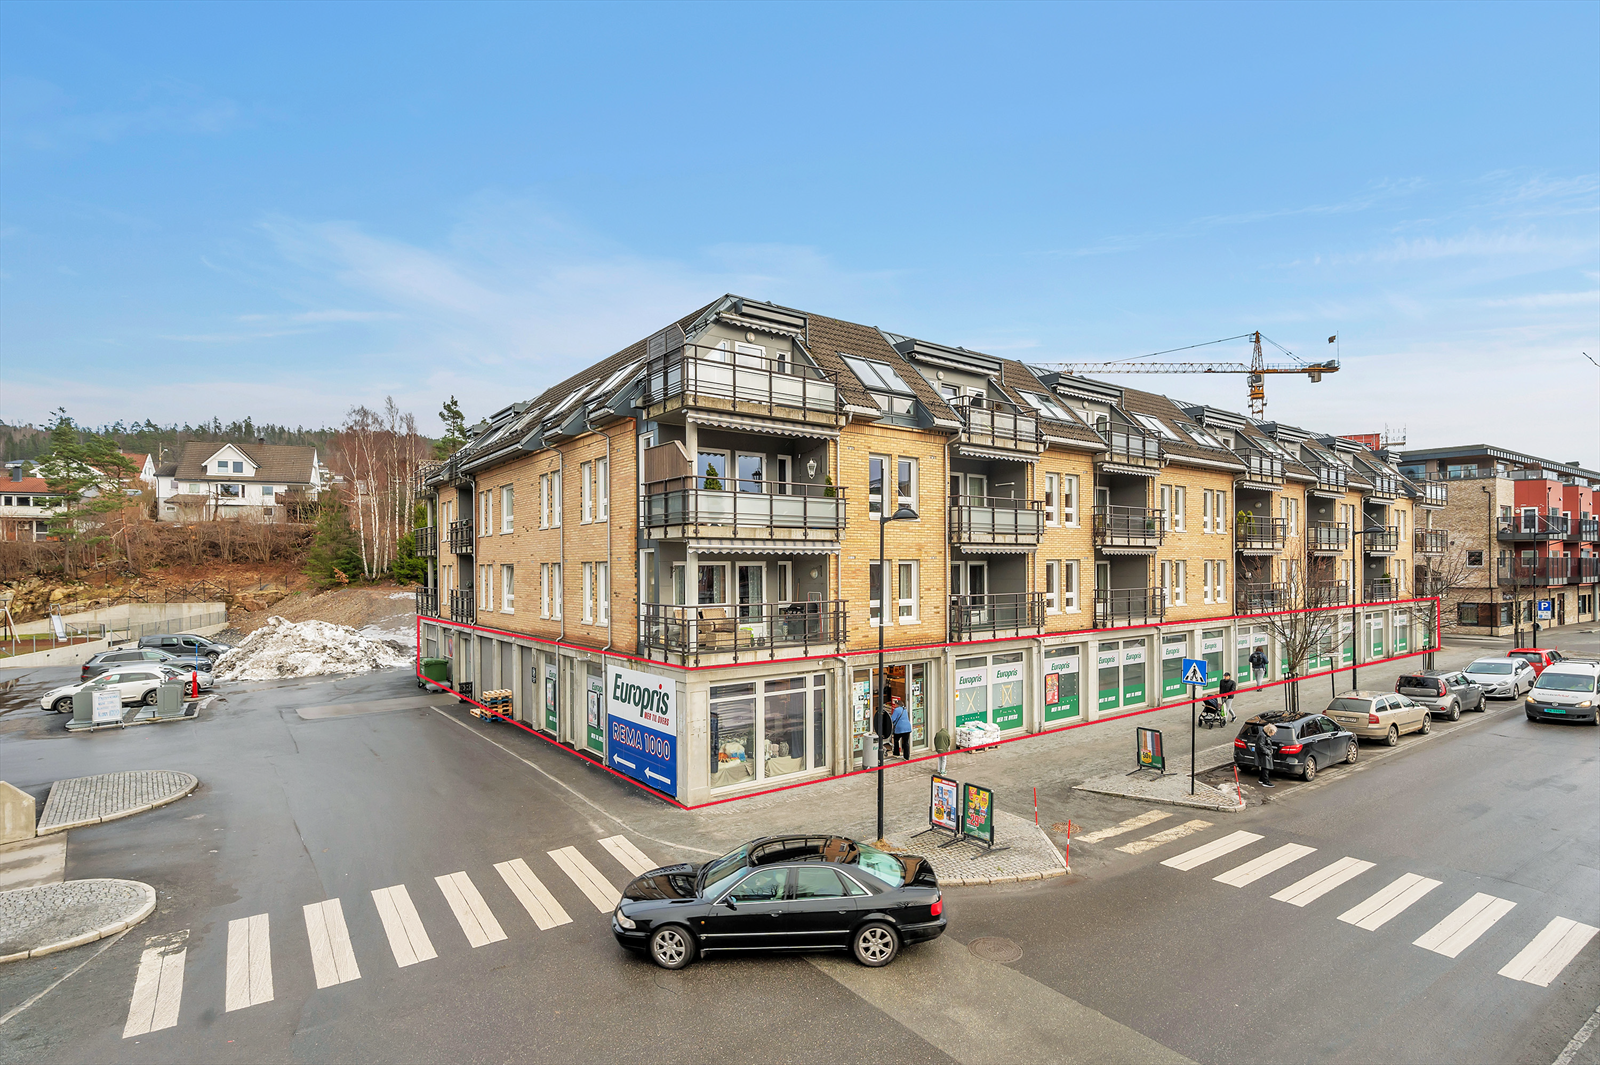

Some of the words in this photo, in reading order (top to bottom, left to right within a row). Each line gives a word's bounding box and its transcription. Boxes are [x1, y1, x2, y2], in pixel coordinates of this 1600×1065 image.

[1541, 602, 1548, 610] P
[1204, 641, 1217, 650] Europris
[1166, 647, 1180, 656] Europris
[1099, 656, 1115, 665] Europris
[1126, 652, 1142, 661] Europris
[1051, 661, 1070, 671] Europris
[997, 668, 1018, 679] Europris
[959, 674, 982, 685] Europris
[613, 673, 670, 717] Europris
[612, 721, 642, 751] REMA
[644, 733, 670, 761] 1000
